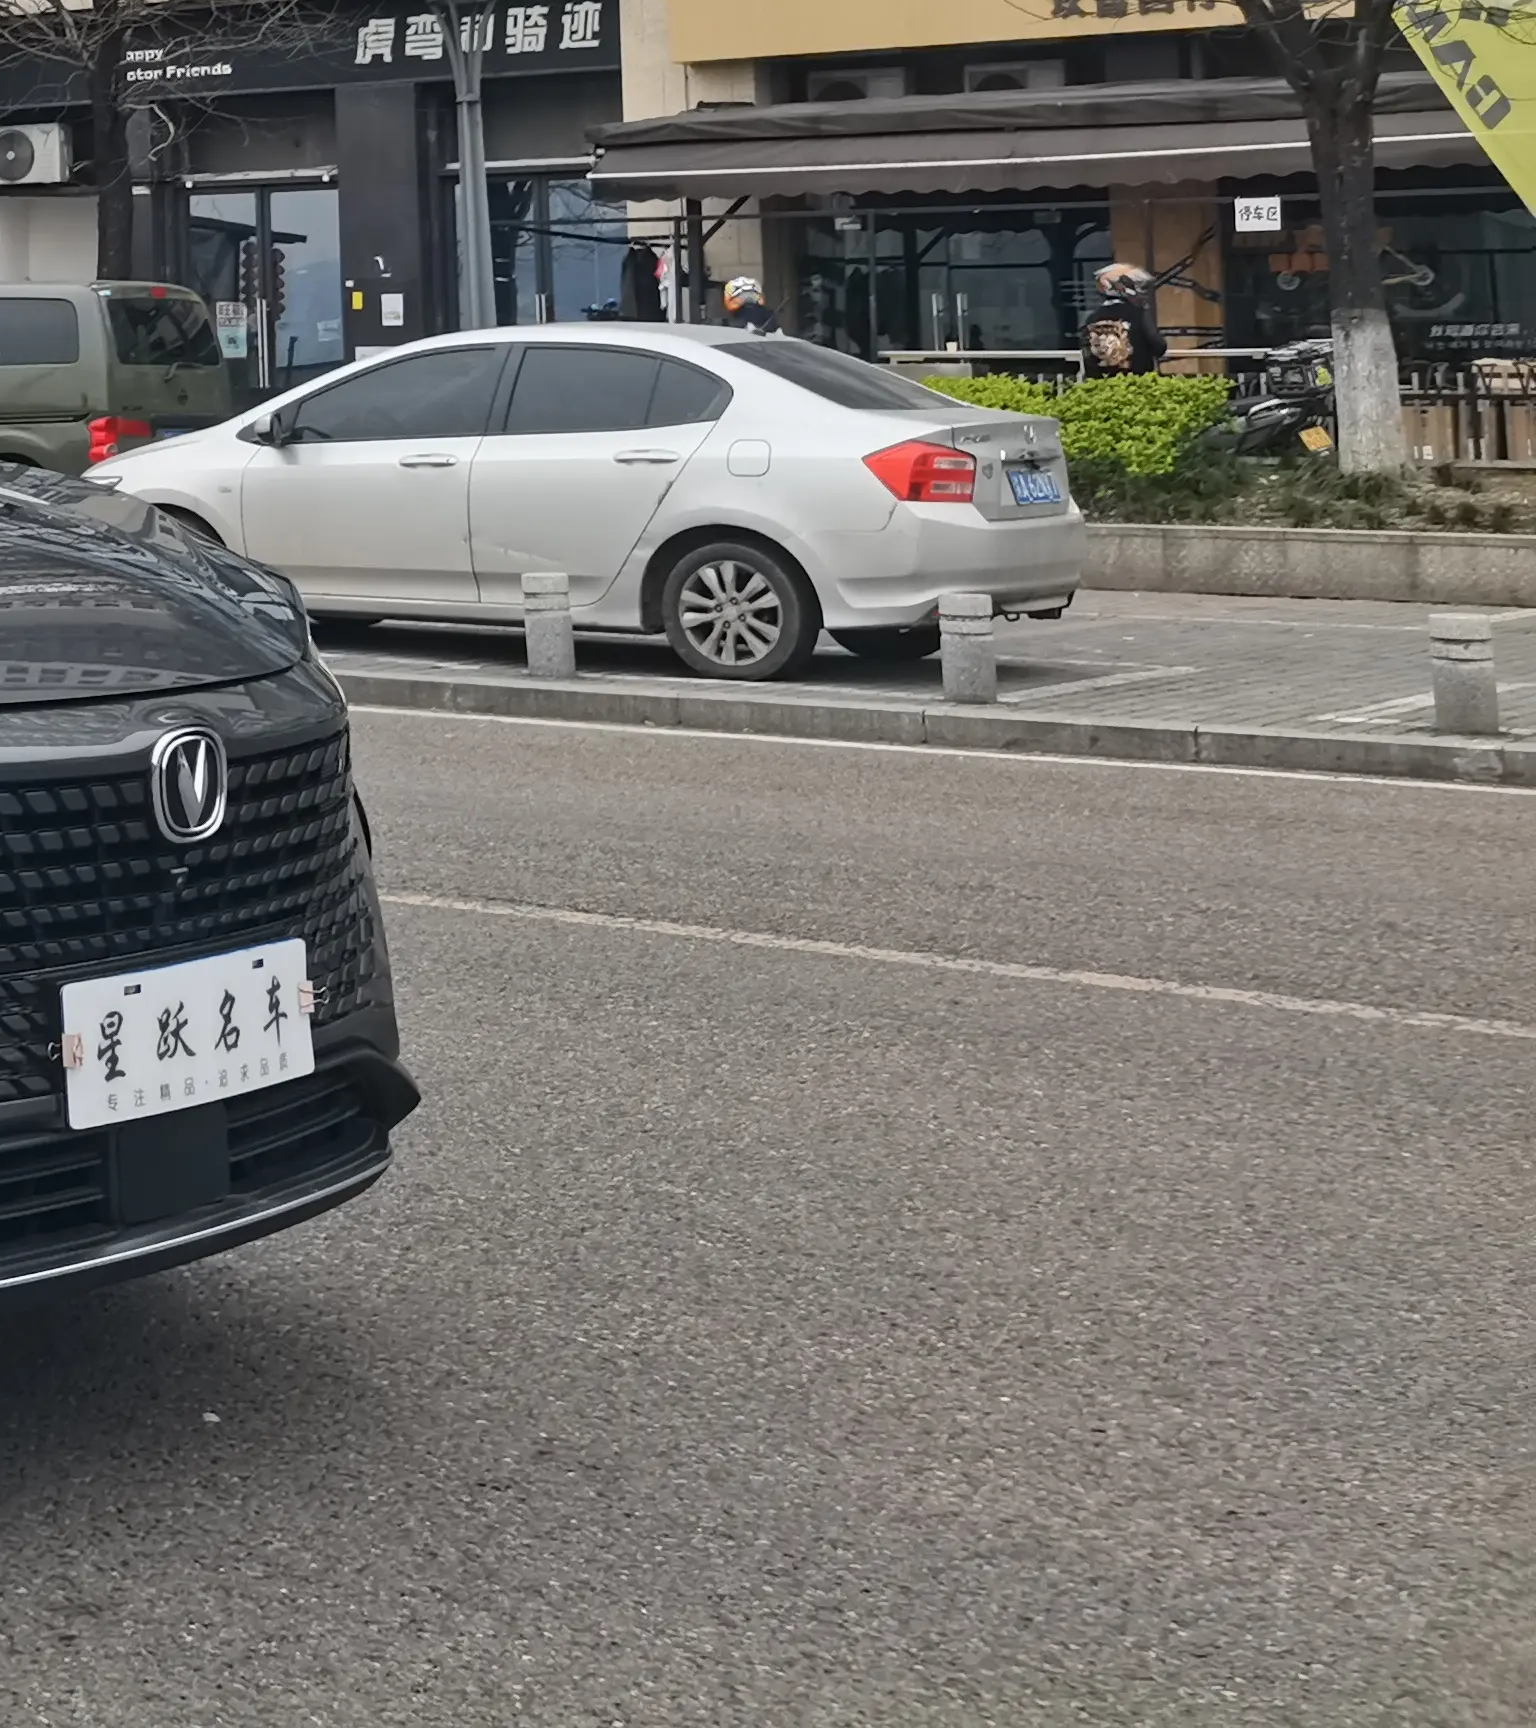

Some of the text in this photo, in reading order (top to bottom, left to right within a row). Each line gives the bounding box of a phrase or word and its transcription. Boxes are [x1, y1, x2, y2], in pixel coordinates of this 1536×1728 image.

[125, 48, 164, 63] appy
[126, 62, 233, 81] otor Friends
[1238, 204, 1278, 222] 停车区
